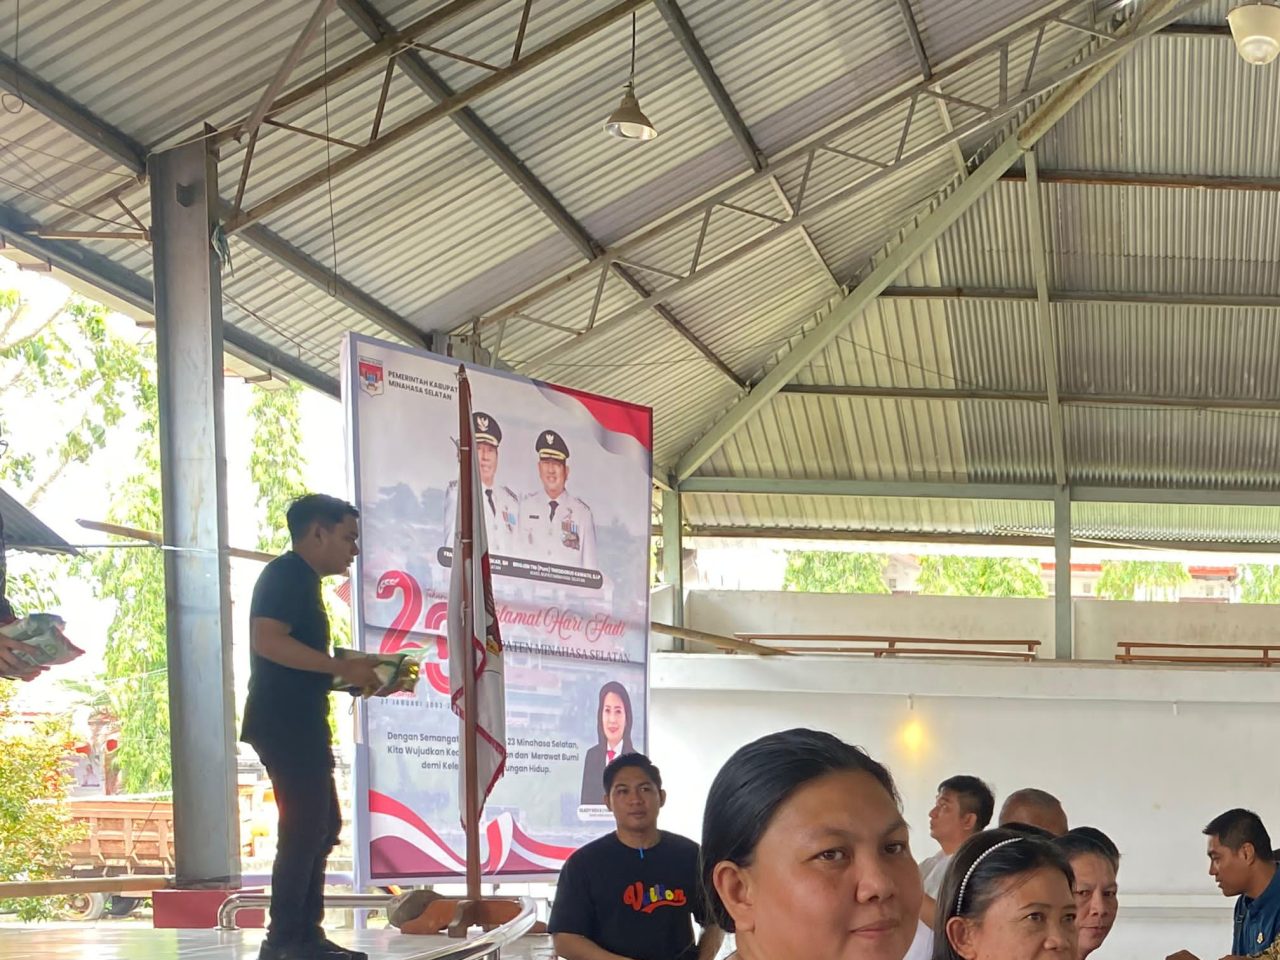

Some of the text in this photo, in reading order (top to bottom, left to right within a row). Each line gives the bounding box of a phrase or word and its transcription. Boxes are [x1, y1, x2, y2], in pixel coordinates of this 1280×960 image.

[388, 370, 458, 392] PEMERINTAH KABUPAT
[388, 380, 452, 401] MINAHASA SELATAN
[495, 604, 626, 643] elamat Hari Jadi
[500, 640, 631, 663] PATEN MINAHASA SELATAN
[387, 732, 419, 743] Dengan
[420, 733, 459, 745] Semangat
[516, 738, 550, 748] Minahasa
[551, 740, 579, 749] Selatan,
[387, 745, 404, 754] Kita
[405, 746, 445, 757] Wujudkan
[514, 751, 529, 759] dan
[531, 752, 561, 760] Merawat
[561, 753, 580, 761] Bumi
[421, 761, 441, 769] demi
